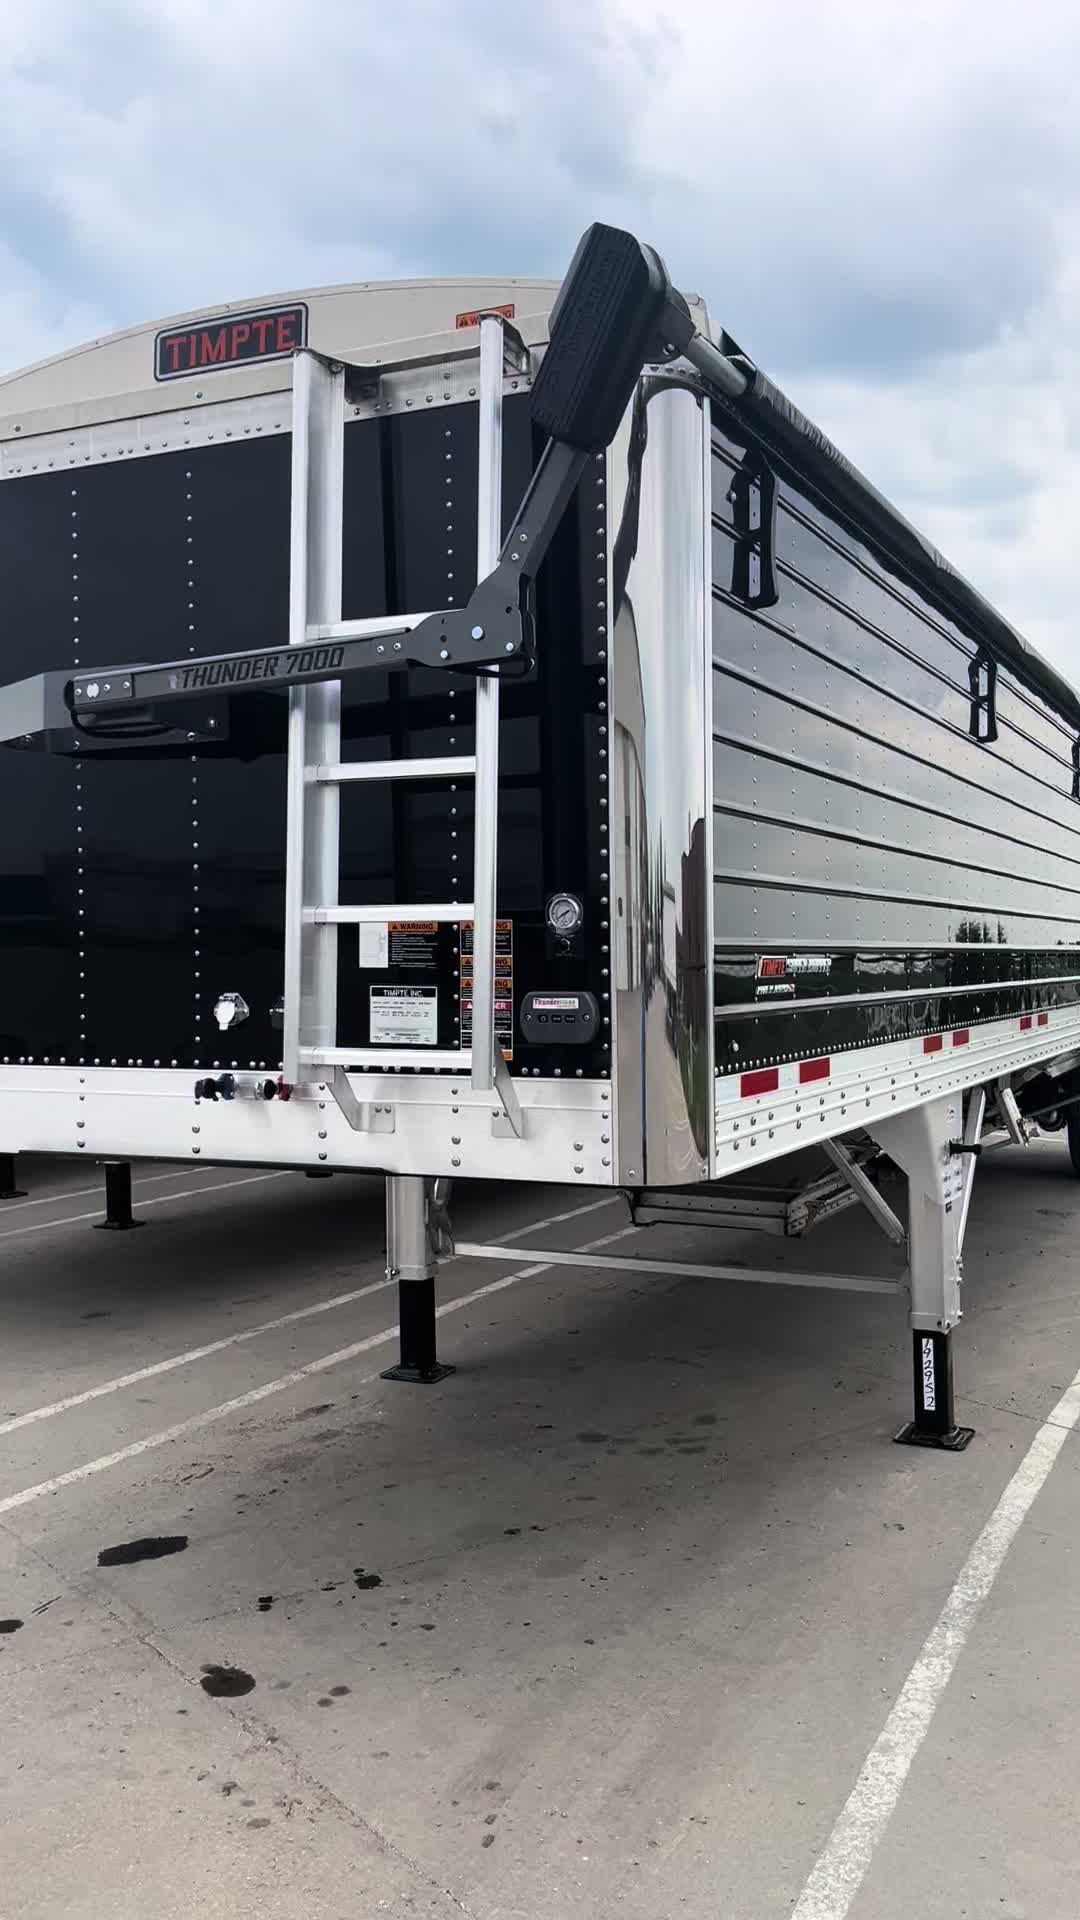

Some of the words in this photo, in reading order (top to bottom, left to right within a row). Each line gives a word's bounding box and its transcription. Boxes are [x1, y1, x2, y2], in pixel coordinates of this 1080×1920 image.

[165, 314, 297, 369] TIMPTE
[182, 655, 280, 688] THUNDER
[286, 647, 345, 674] 7000
[400, 922, 434, 930] WARNING
[383, 989, 409, 997] TIMPTE
[923, 1338, 935, 1408] 192952
